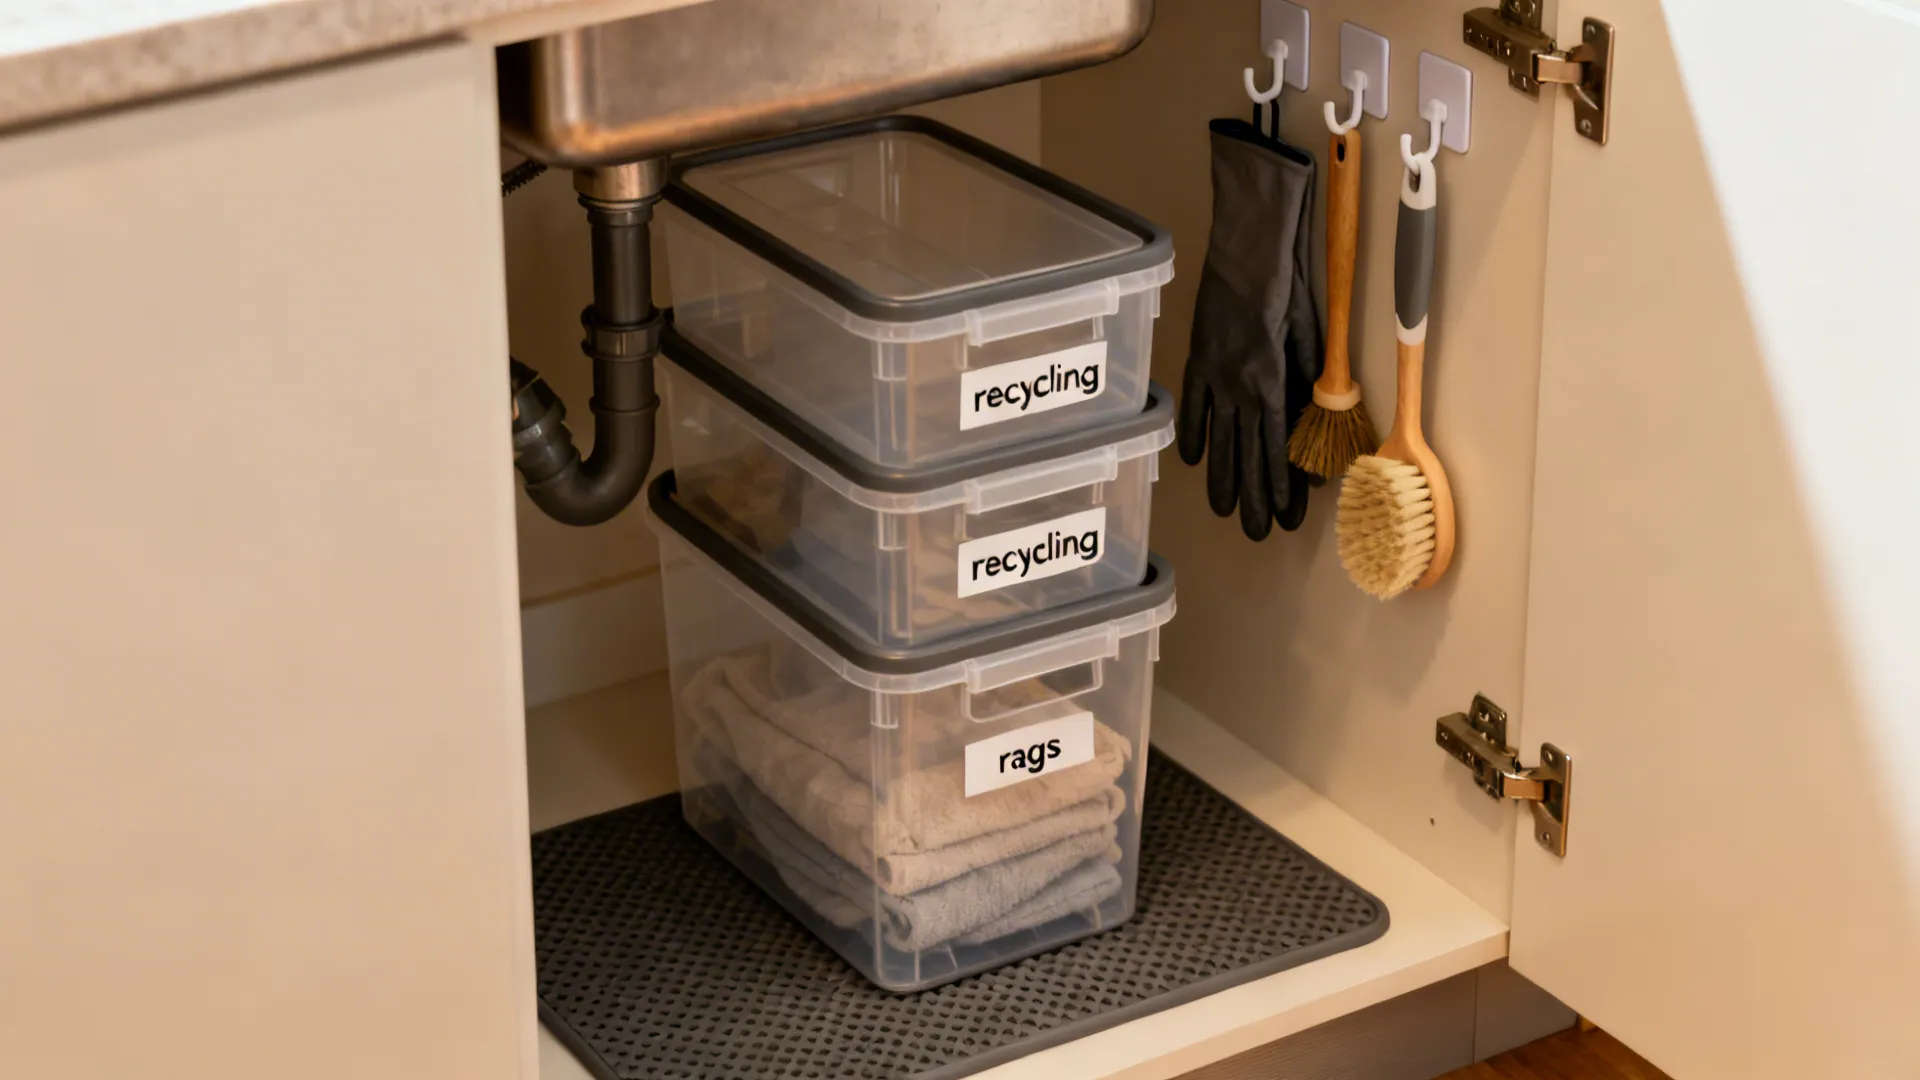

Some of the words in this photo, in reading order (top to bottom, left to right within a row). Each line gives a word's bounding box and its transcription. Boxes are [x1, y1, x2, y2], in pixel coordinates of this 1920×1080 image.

[974, 363, 1100, 412] recycling
[972, 530, 1099, 581] recycling
[998, 738, 1062, 774] rags
